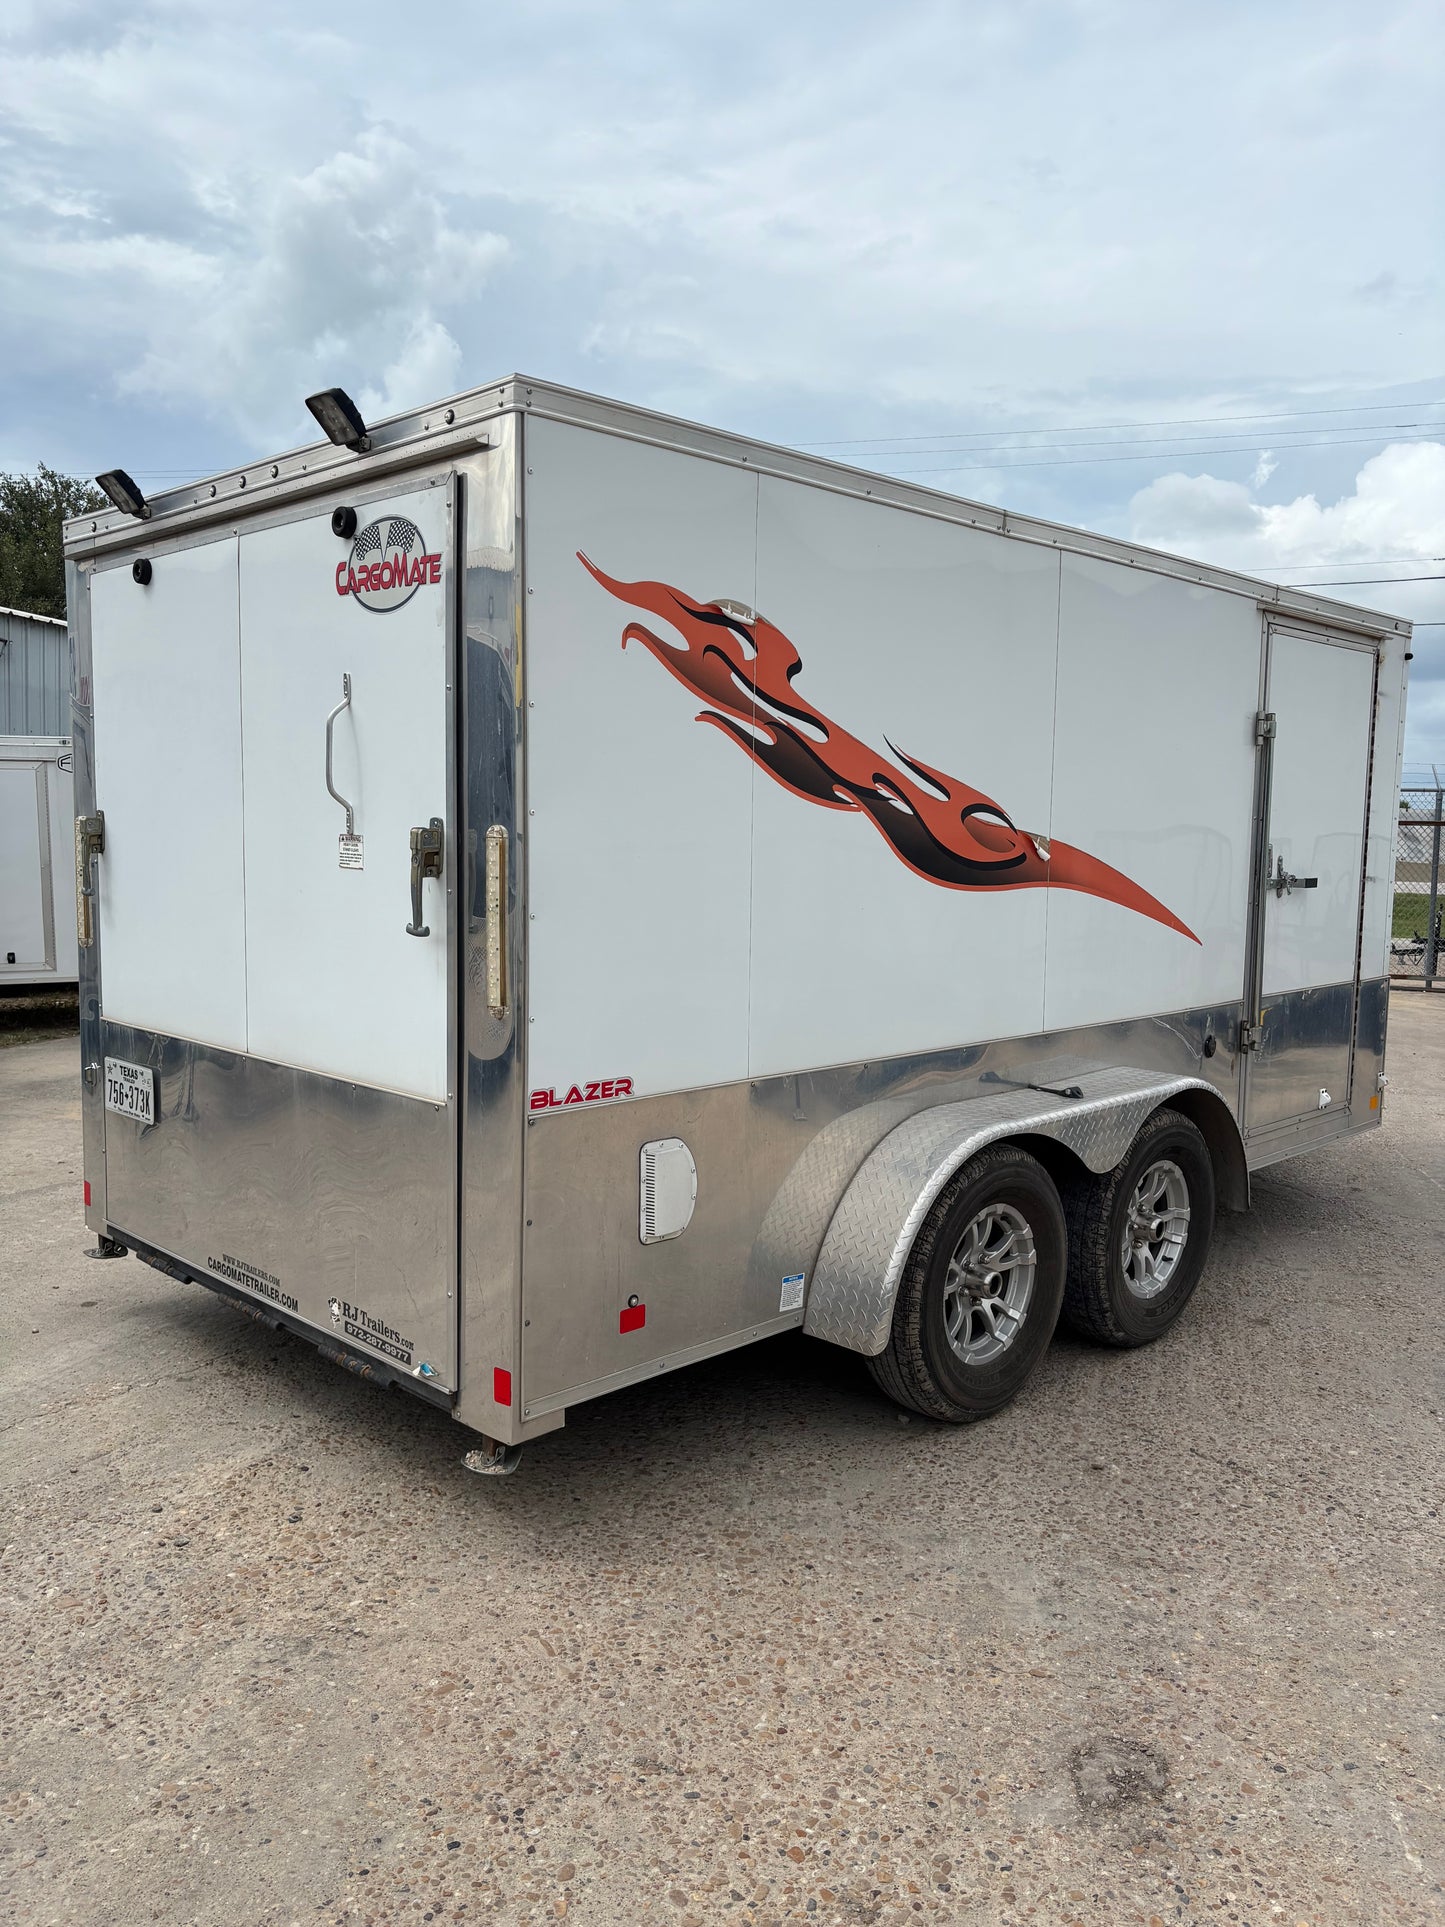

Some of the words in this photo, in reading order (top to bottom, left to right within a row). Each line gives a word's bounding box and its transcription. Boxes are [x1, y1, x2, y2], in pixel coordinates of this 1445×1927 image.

[336, 552, 442, 596] CARGOMATE
[119, 1065, 139, 1080] TEXAS
[530, 1078, 633, 1110] BLAZER
[207, 1256, 299, 1313] CARGOMATETRAILER.COM
[342, 1301, 359, 1322] RJ
